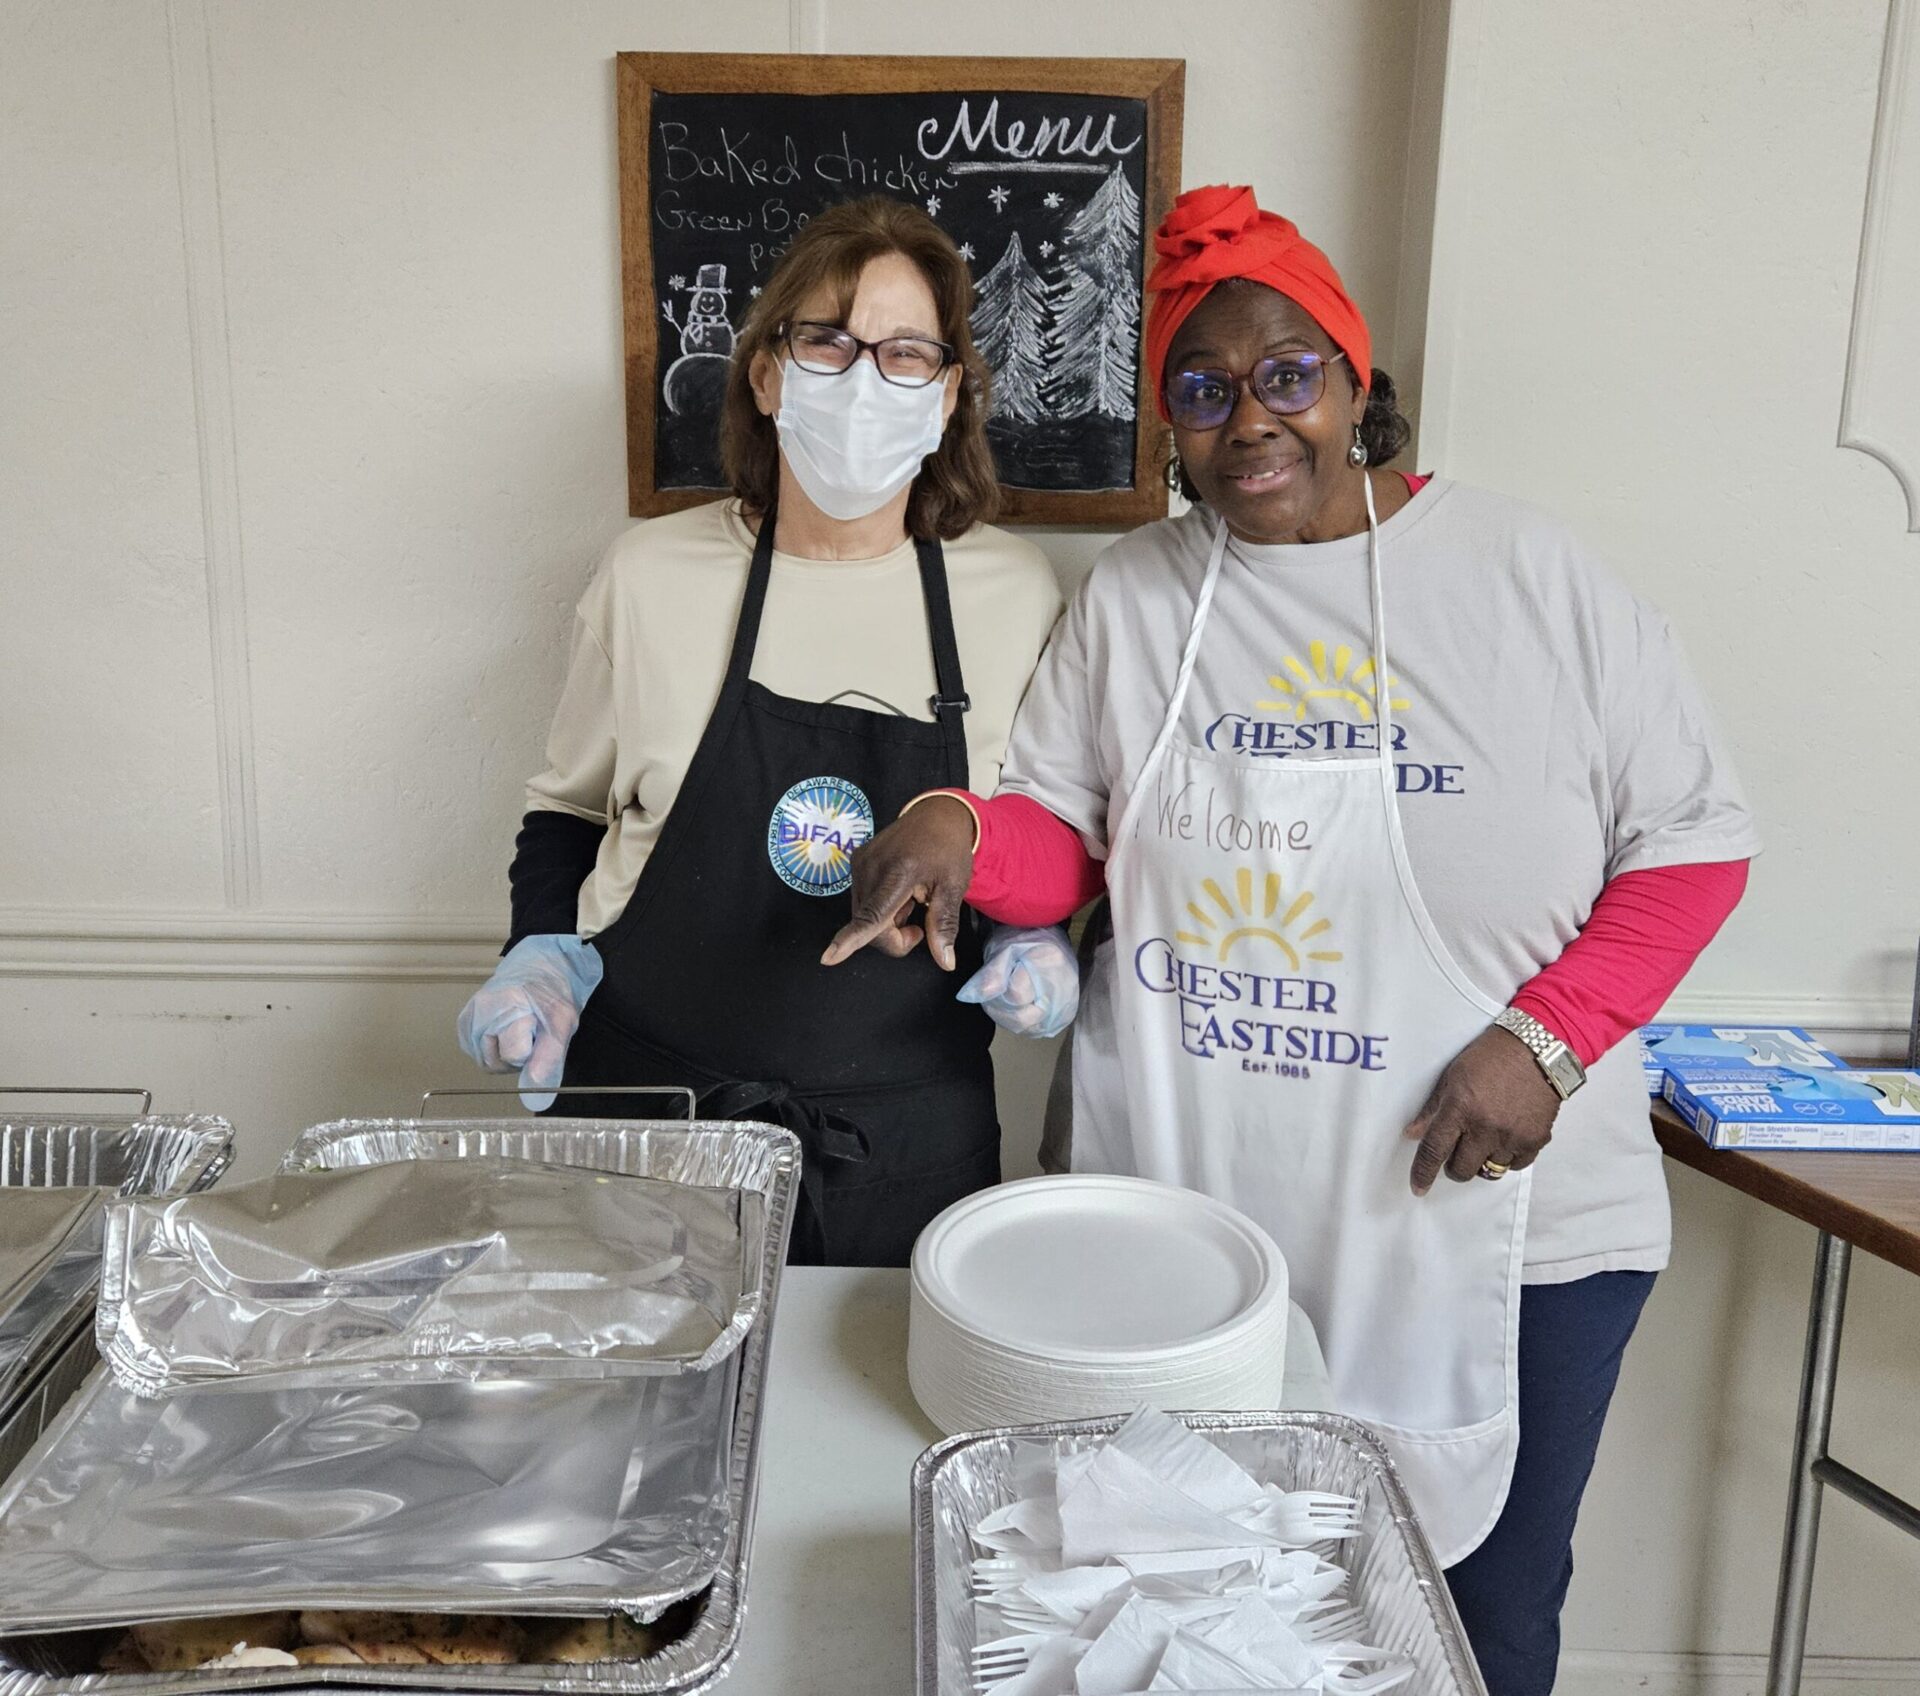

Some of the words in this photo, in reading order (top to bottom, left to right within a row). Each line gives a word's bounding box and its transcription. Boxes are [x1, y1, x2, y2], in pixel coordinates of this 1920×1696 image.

[918, 96, 1142, 159] Menu
[1205, 713, 1409, 753] CHESTER
[786, 777, 843, 800] DELAWARE
[845, 783, 872, 818] COUNTY
[1158, 771, 1312, 852] Welcome
[1135, 938, 1337, 1014] CHESTER
[1179, 995, 1389, 1071] EASTSIDE
